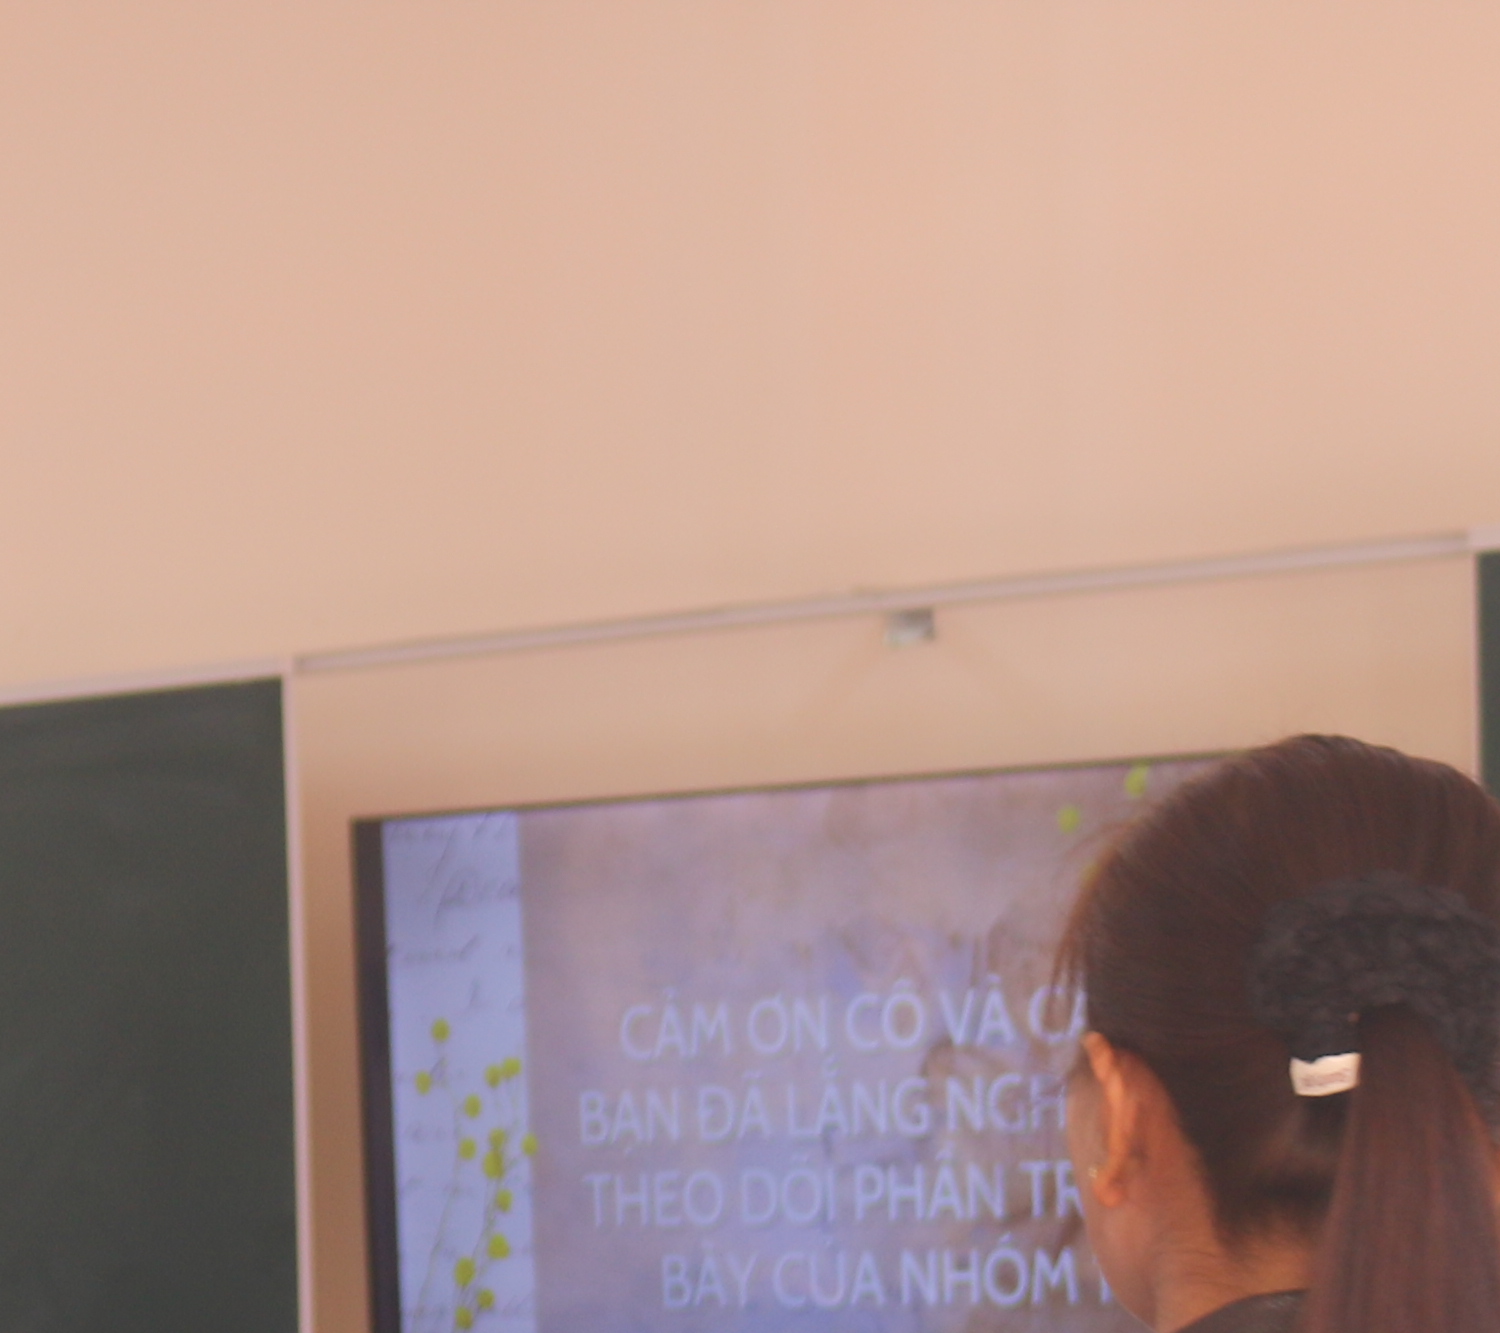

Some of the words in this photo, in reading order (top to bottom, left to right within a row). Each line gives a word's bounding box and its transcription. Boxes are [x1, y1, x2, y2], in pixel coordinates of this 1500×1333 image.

[620, 986, 732, 1060] CẢM
[748, 990, 828, 1053] ƠN
[845, 978, 926, 1050] CÔ
[941, 974, 1017, 1046] VÀ
[580, 1088, 681, 1155] BẠN
[698, 1069, 773, 1142] ĐÃ
[787, 1052, 932, 1139] LẮNG
[945, 1073, 1068, 1133] NGH
[582, 1168, 725, 1228] THEO
[740, 1152, 836, 1226] DÕI
[852, 1141, 1006, 1222] PHẦN
[1019, 1159, 1084, 1219] TR
[772, 1237, 886, 1308] CỦA
[901, 1230, 1080, 1307] NHÓM
